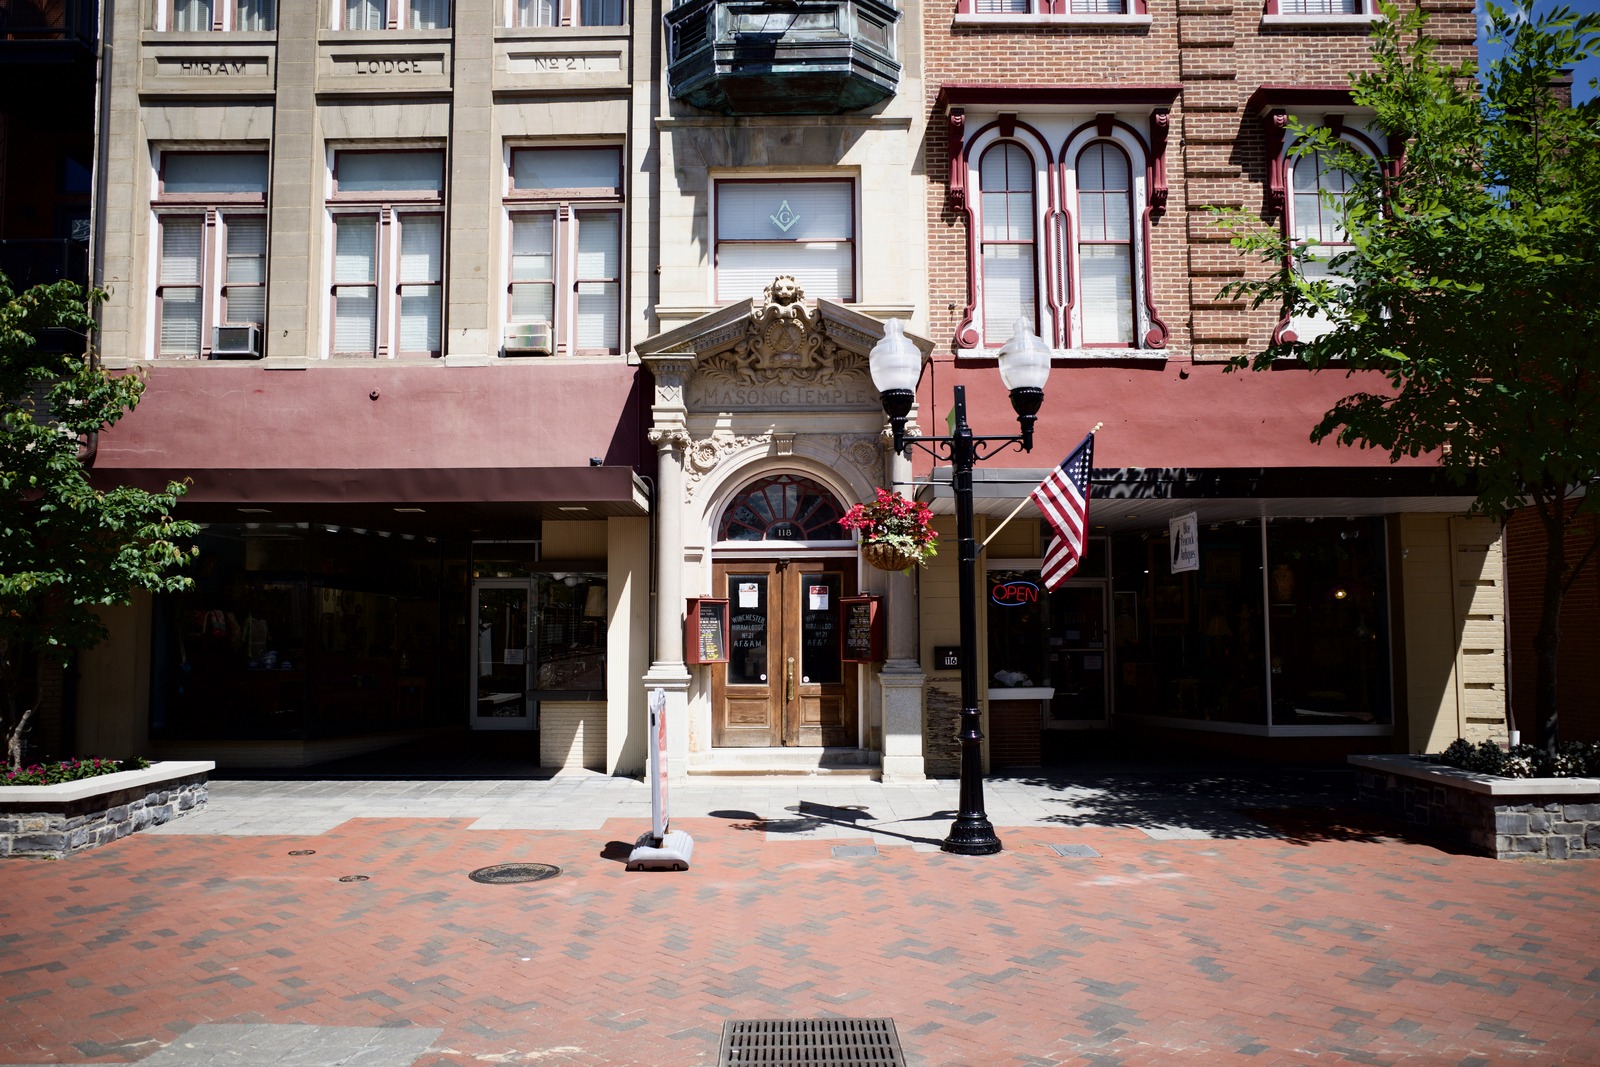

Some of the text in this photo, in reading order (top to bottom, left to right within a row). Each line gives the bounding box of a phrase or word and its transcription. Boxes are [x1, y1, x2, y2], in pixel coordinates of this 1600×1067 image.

[181, 60, 246, 75] HIRAM
[355, 59, 422, 74] LODGE
[780, 212, 790, 223] G
[704, 385, 867, 405] MASONIC TEMPLE
[778, 529, 792, 537] 118
[992, 584, 1038, 603] OPEN
[731, 614, 766, 624] WINCHESTER
[945, 657, 957, 665] 116
